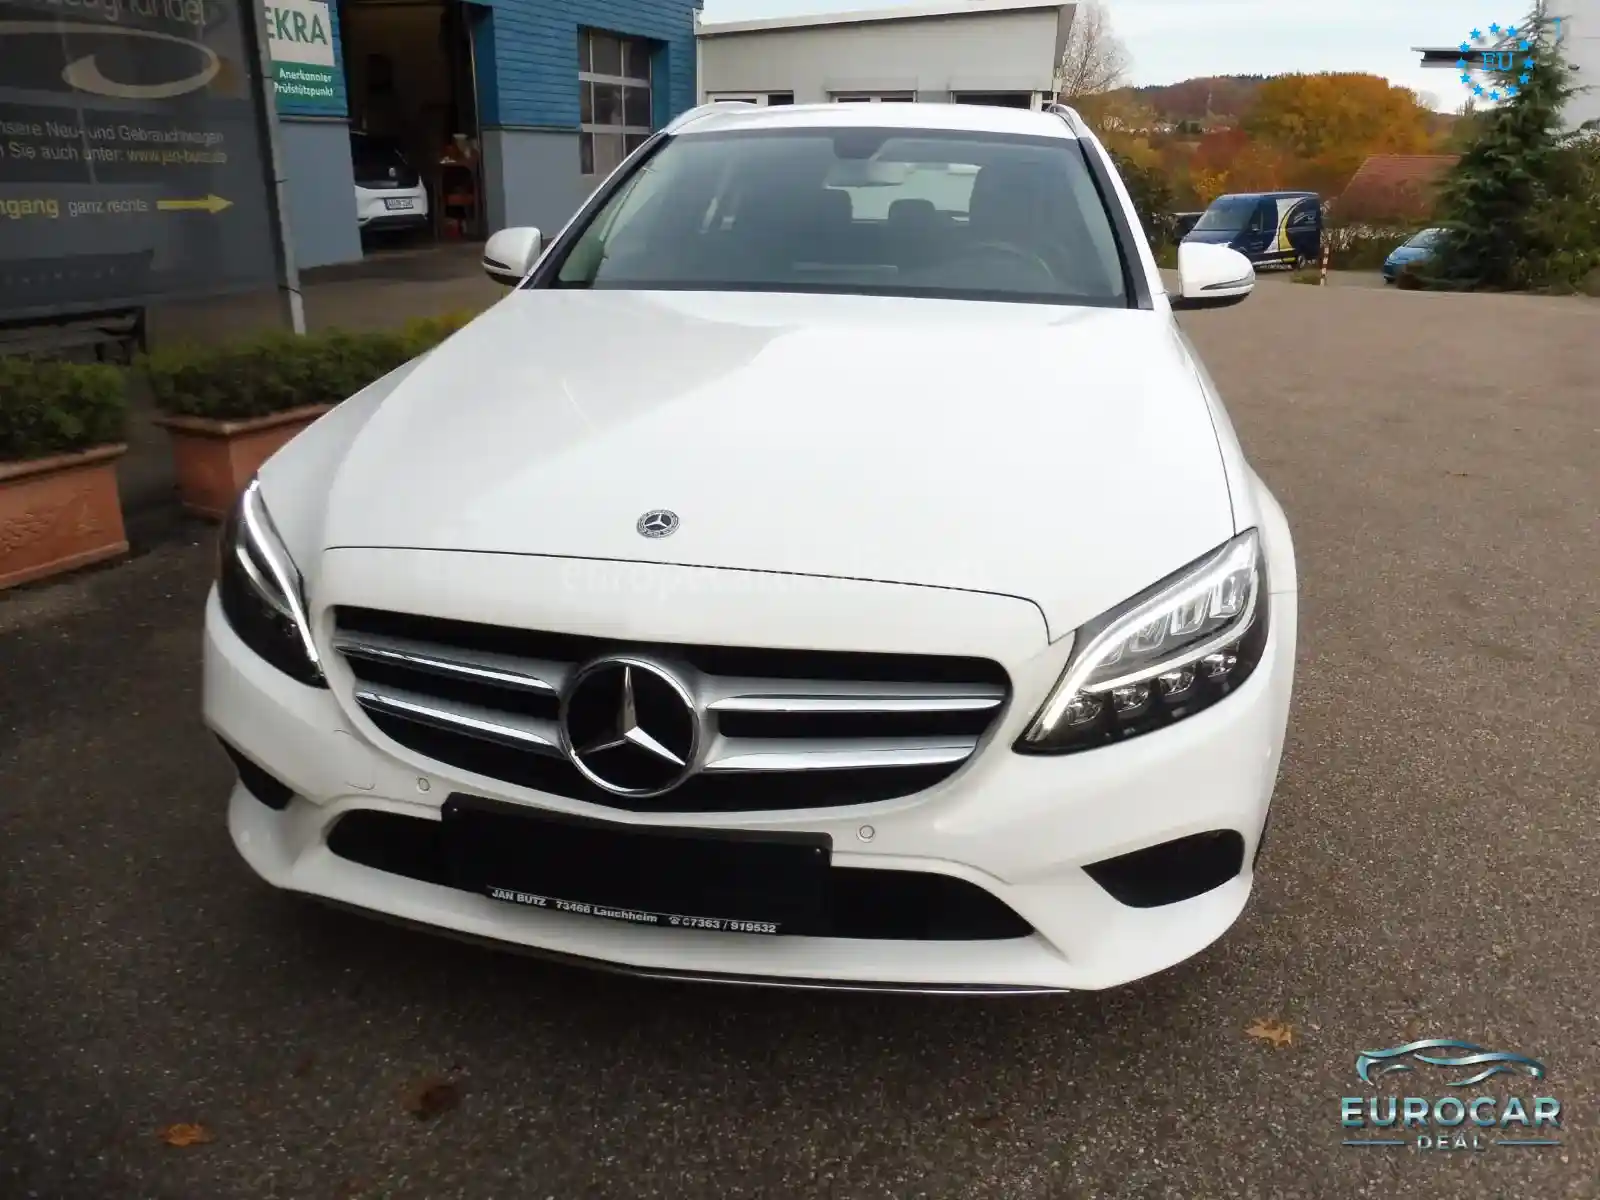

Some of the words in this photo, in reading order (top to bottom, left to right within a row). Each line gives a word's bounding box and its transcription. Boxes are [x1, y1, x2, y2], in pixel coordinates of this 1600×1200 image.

[88, 125, 116, 140] und
[8, 141, 36, 159] Sie
[41, 143, 78, 161] auch
[68, 201, 104, 217] ganz
[107, 199, 149, 213] rechts
[492, 889, 514, 901] JAN
[516, 893, 547, 907] BUTZ
[593, 906, 658, 923] Lauchheim
[730, 921, 777, 934] 919532
